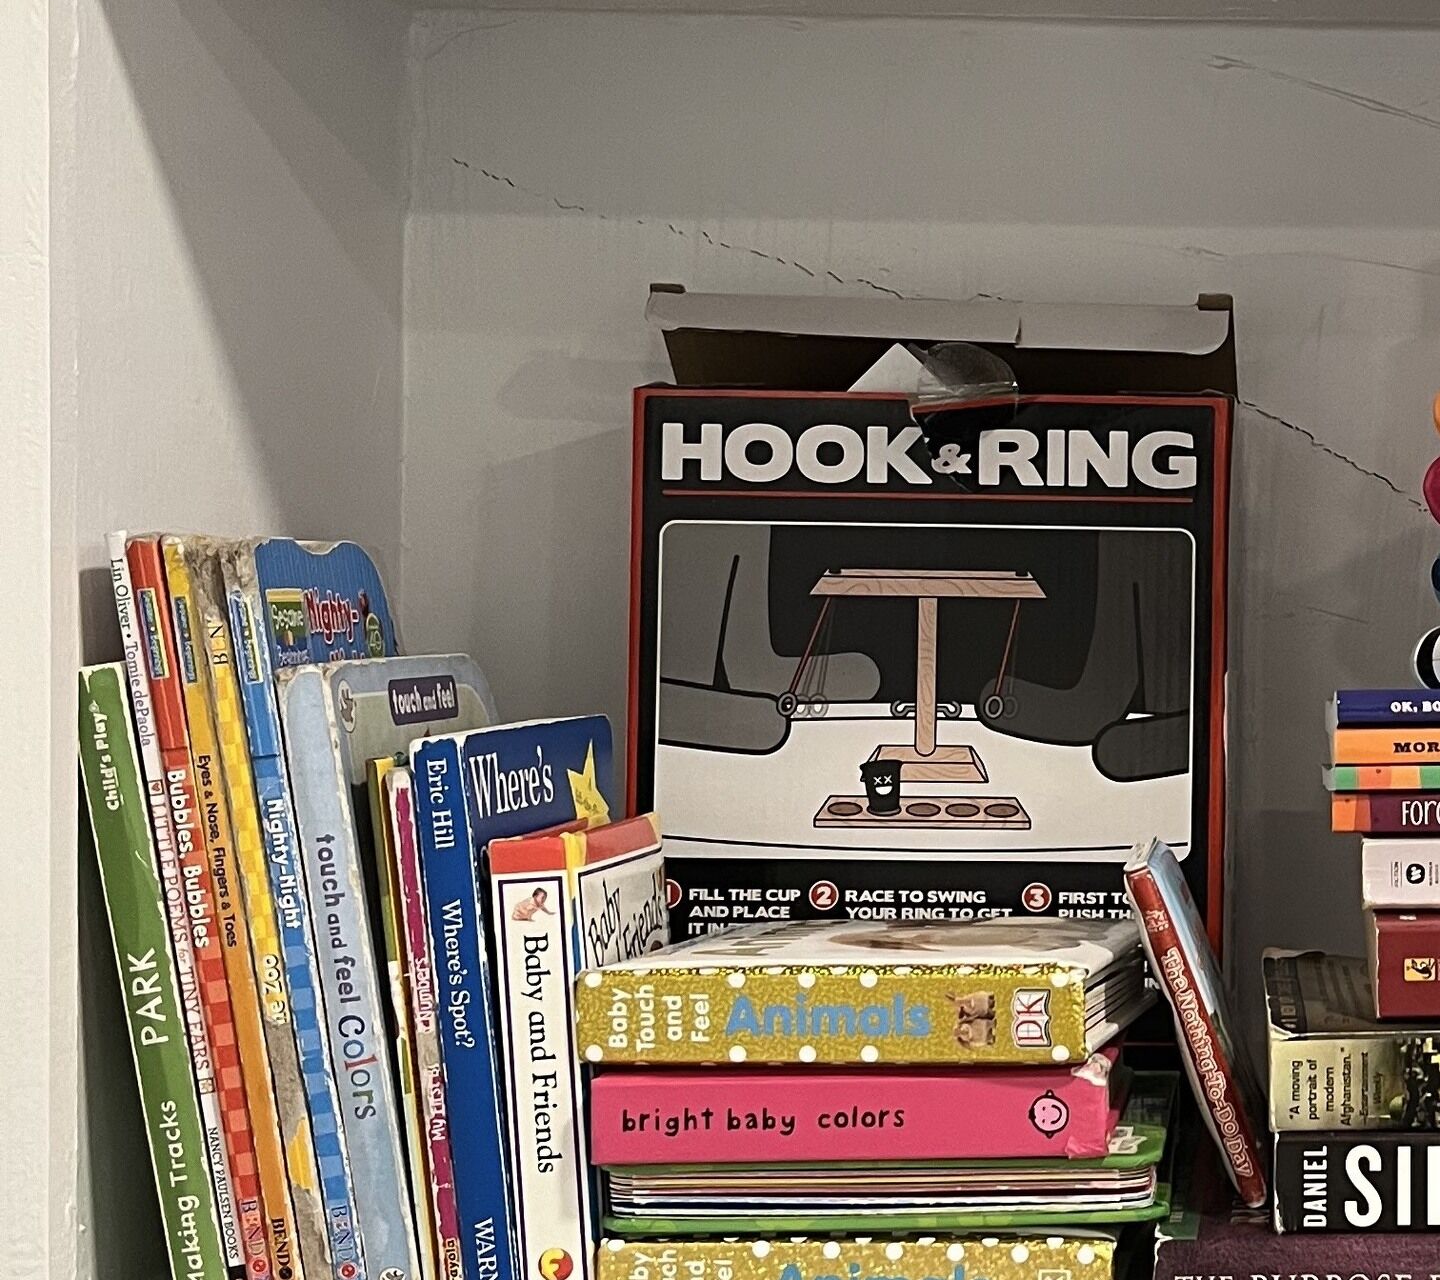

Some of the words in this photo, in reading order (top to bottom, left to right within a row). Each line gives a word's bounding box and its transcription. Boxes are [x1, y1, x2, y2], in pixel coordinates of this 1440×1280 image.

[660, 422, 934, 486] HOOK
[978, 428, 1198, 491] RING
[111, 558, 123, 583] Lin
[115, 584, 132, 635] Oliver
[125, 641, 142, 688] Tomie
[134, 690, 155, 747] dePaola
[1390, 700, 1418, 715] OK,
[426, 757, 450, 805] Eric
[469, 745, 554, 818] Where's
[431, 808, 455, 849] Hill
[315, 833, 346, 908] touch
[844, 889, 895, 904] RACE
[898, 889, 924, 904] TO
[927, 889, 987, 905] SWING
[328, 913, 348, 950] and
[441, 898, 469, 986] Where's
[333, 954, 361, 1004] feel
[520, 931, 552, 1002] Baby
[127, 947, 170, 1047] PARK
[448, 989, 476, 1049] Spot?
[724, 993, 933, 1039] Animals
[527, 1010, 556, 1063] and
[337, 1015, 379, 1121] Colors
[158, 1099, 188, 1189] Tracks
[531, 1073, 563, 1173] Friends
[622, 1107, 714, 1137] bright
[726, 1107, 797, 1137] baby
[816, 1105, 906, 1130] colors
[1302, 1145, 1328, 1228] DANIEL
